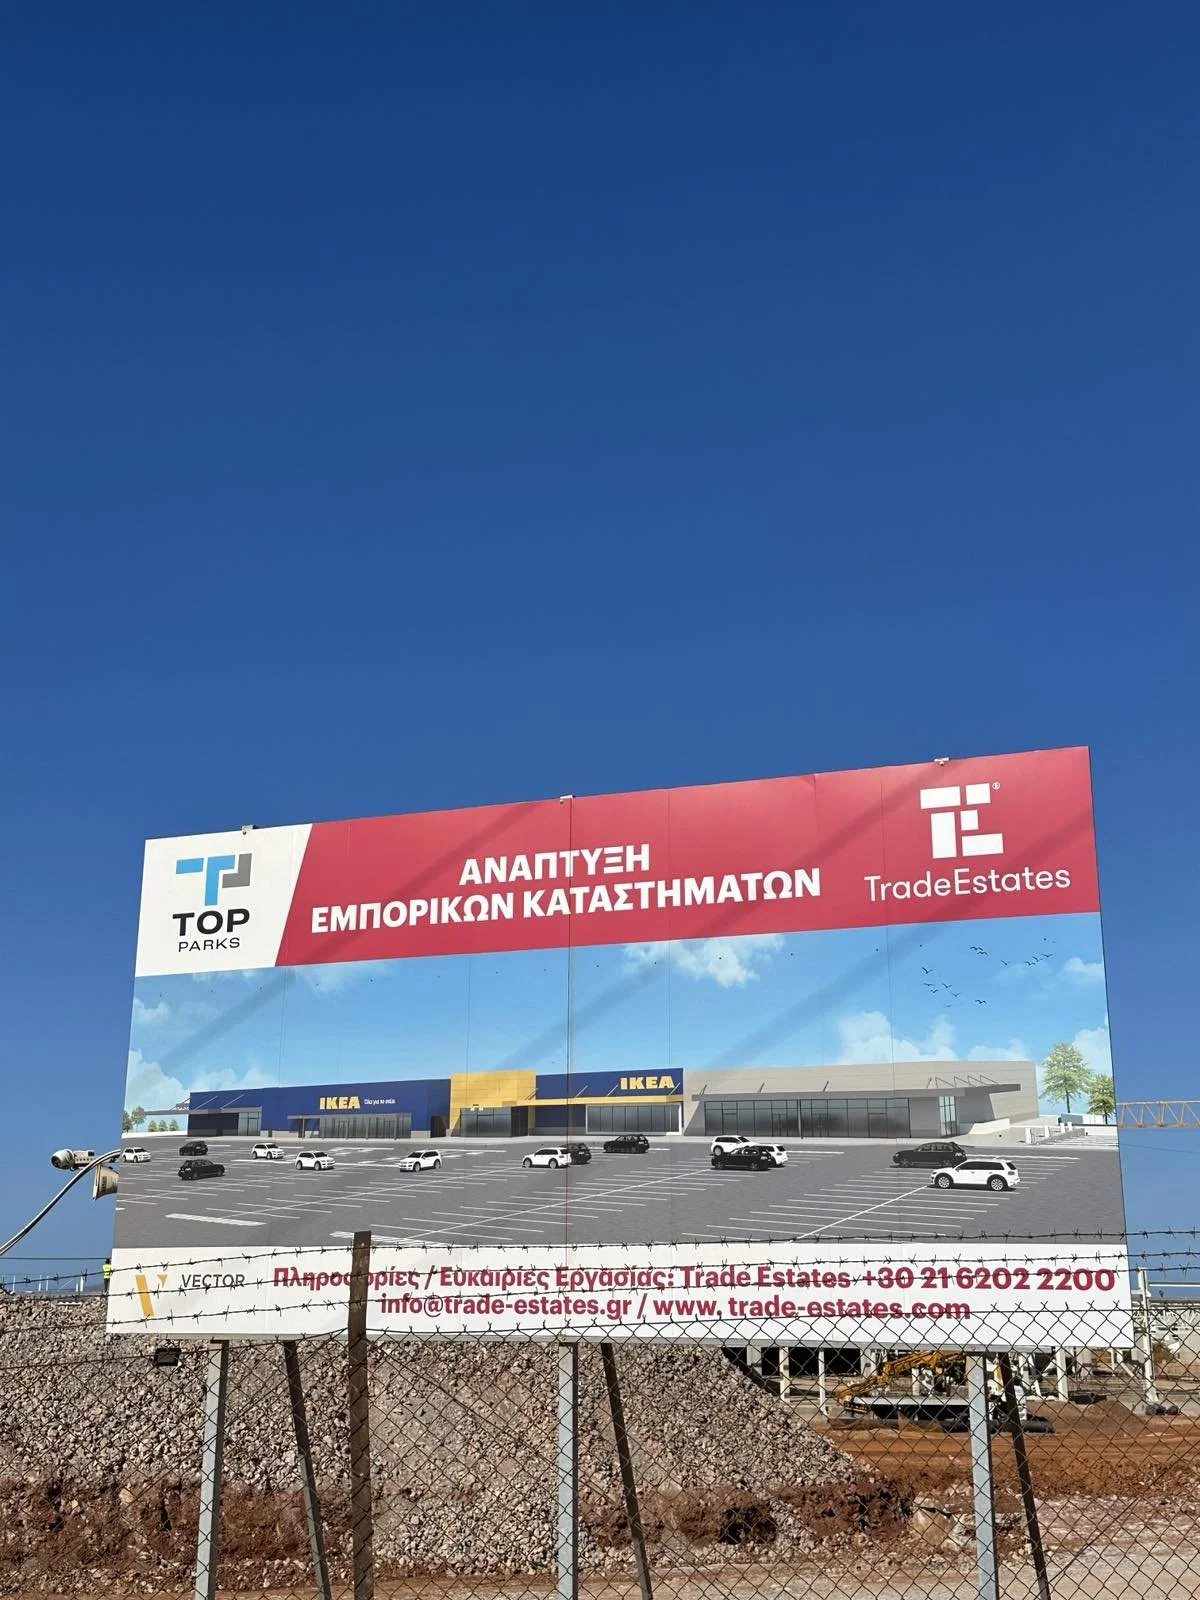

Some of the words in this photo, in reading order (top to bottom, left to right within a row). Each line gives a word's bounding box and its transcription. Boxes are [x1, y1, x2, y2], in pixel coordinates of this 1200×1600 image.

[459, 843, 651, 887] ΑΝΑΠΤΥΞΗ
[864, 865, 1071, 903] TradeEstates
[311, 892, 514, 934] ΕΜΠΟΡΙΚΩΝ
[522, 867, 821, 919] ΚΑΤΑΣΤΗΜΑΤΩΝ
[172, 908, 250, 937] TOP
[178, 937, 241, 953] PARKS
[620, 1075, 675, 1092] IKEA
[319, 1096, 361, 1110] IKEA
[181, 1273, 246, 1290] VECTOR
[440, 1266, 550, 1291] Ευκαιρίες
[555, 1265, 675, 1291] Εργασίας:
[680, 1266, 752, 1288] Trade
[757, 1266, 852, 1288] Estates
[863, 1266, 914, 1290] +30
[1036, 1267, 1116, 1291] 2200
[381, 1293, 633, 1320] info@trade-estates.gr
